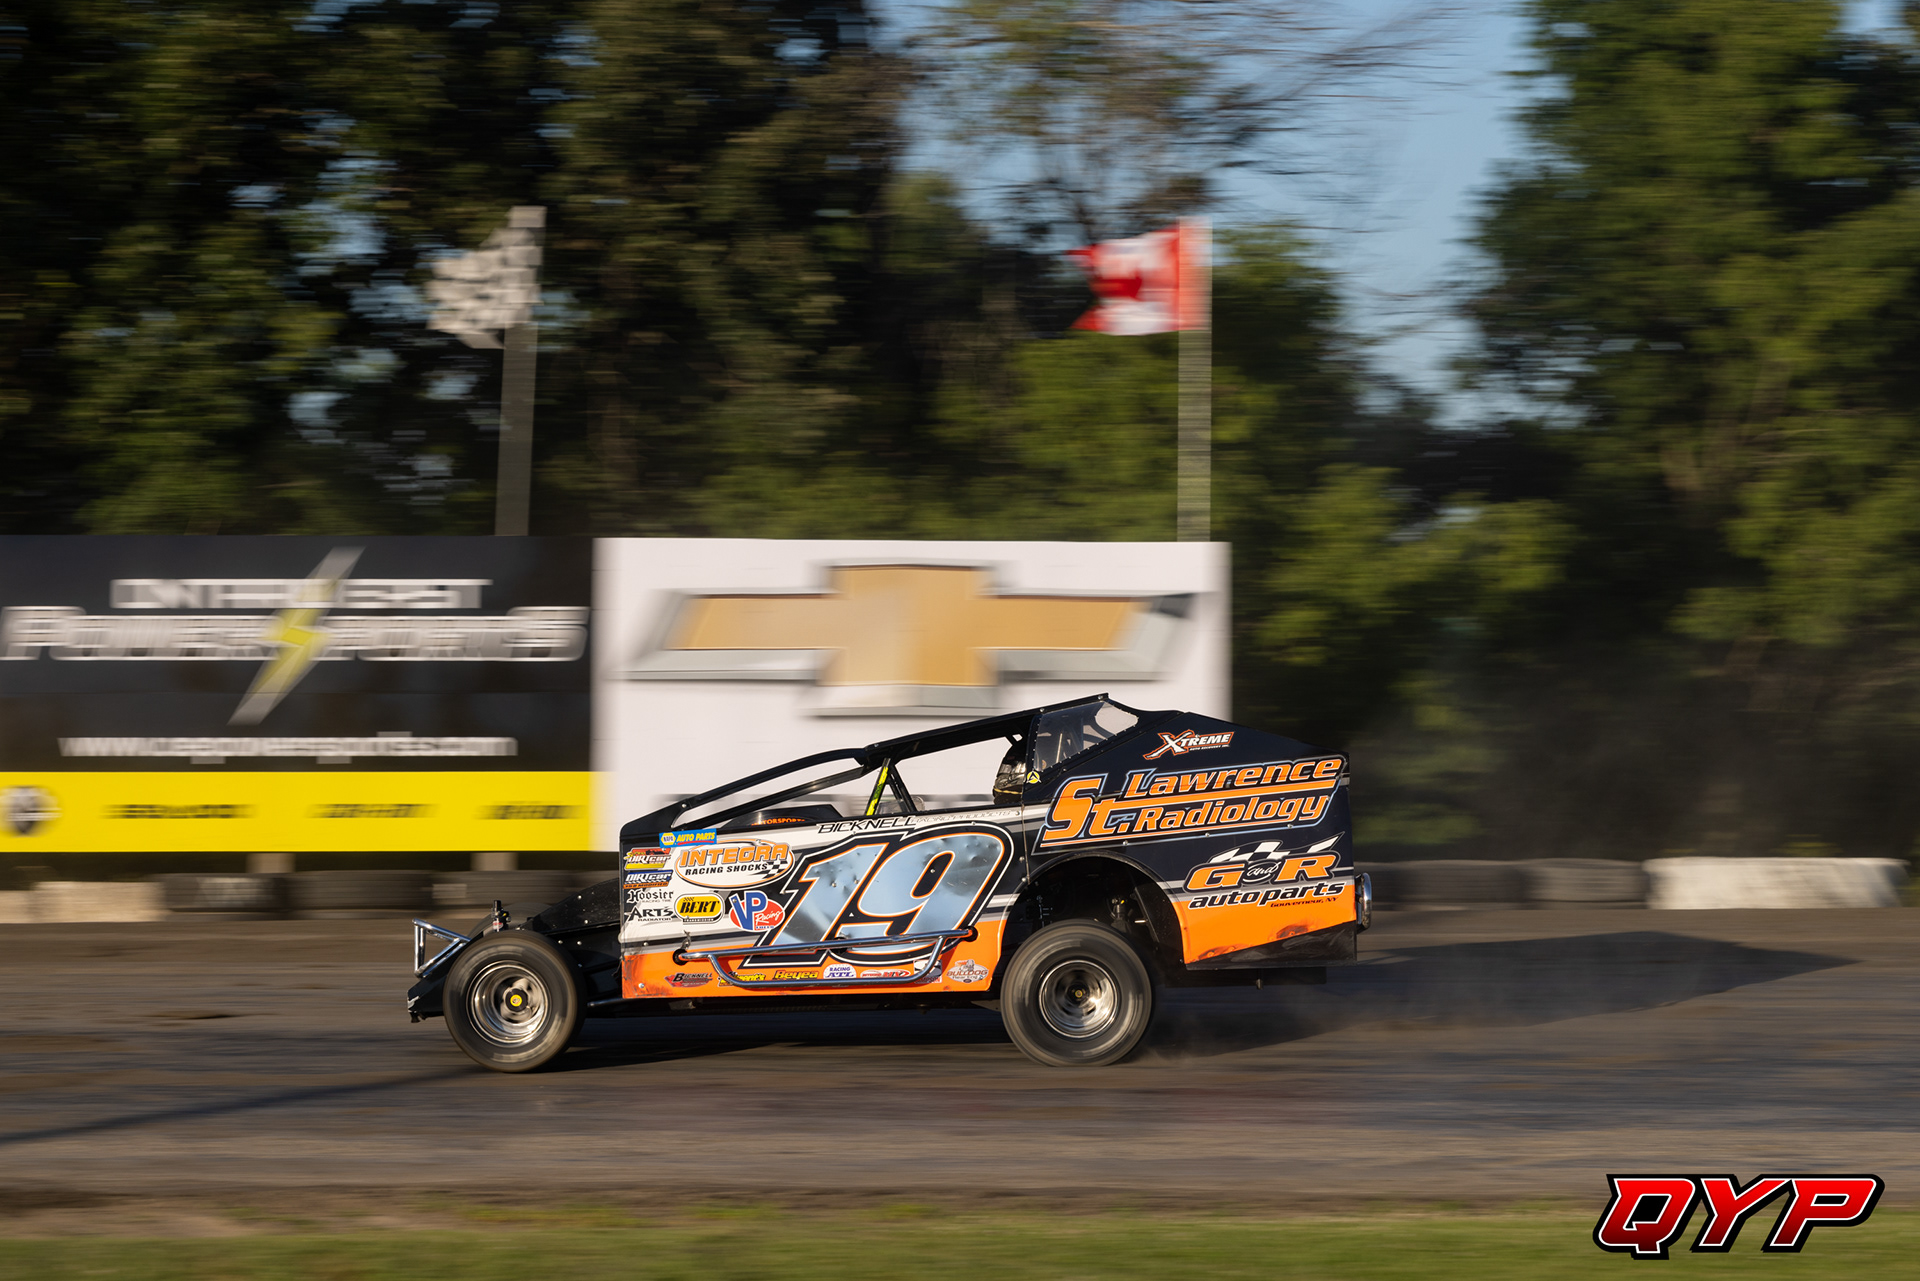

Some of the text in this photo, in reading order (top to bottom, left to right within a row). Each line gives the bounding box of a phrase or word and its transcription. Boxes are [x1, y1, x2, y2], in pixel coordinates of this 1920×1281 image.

[1144, 731, 1233, 759] XTREME
[1043, 758, 1342, 841] St. Lawrence
[1133, 795, 1331, 832] Radiology
[818, 816, 917, 834] BICKNELL
[676, 834, 695, 843] AUTO
[695, 832, 716, 841] PARTS
[679, 843, 789, 867] INTEGRA
[684, 863, 768, 876] RACING SHOCKS
[629, 888, 674, 902] Hoosier
[756, 826, 1011, 958] 19
[680, 901, 720, 914] BERT
[729, 891, 767, 931] VP
[755, 911, 784, 926] Racing
[774, 970, 819, 980] Beyea
[946, 969, 988, 977] BULLDOG
